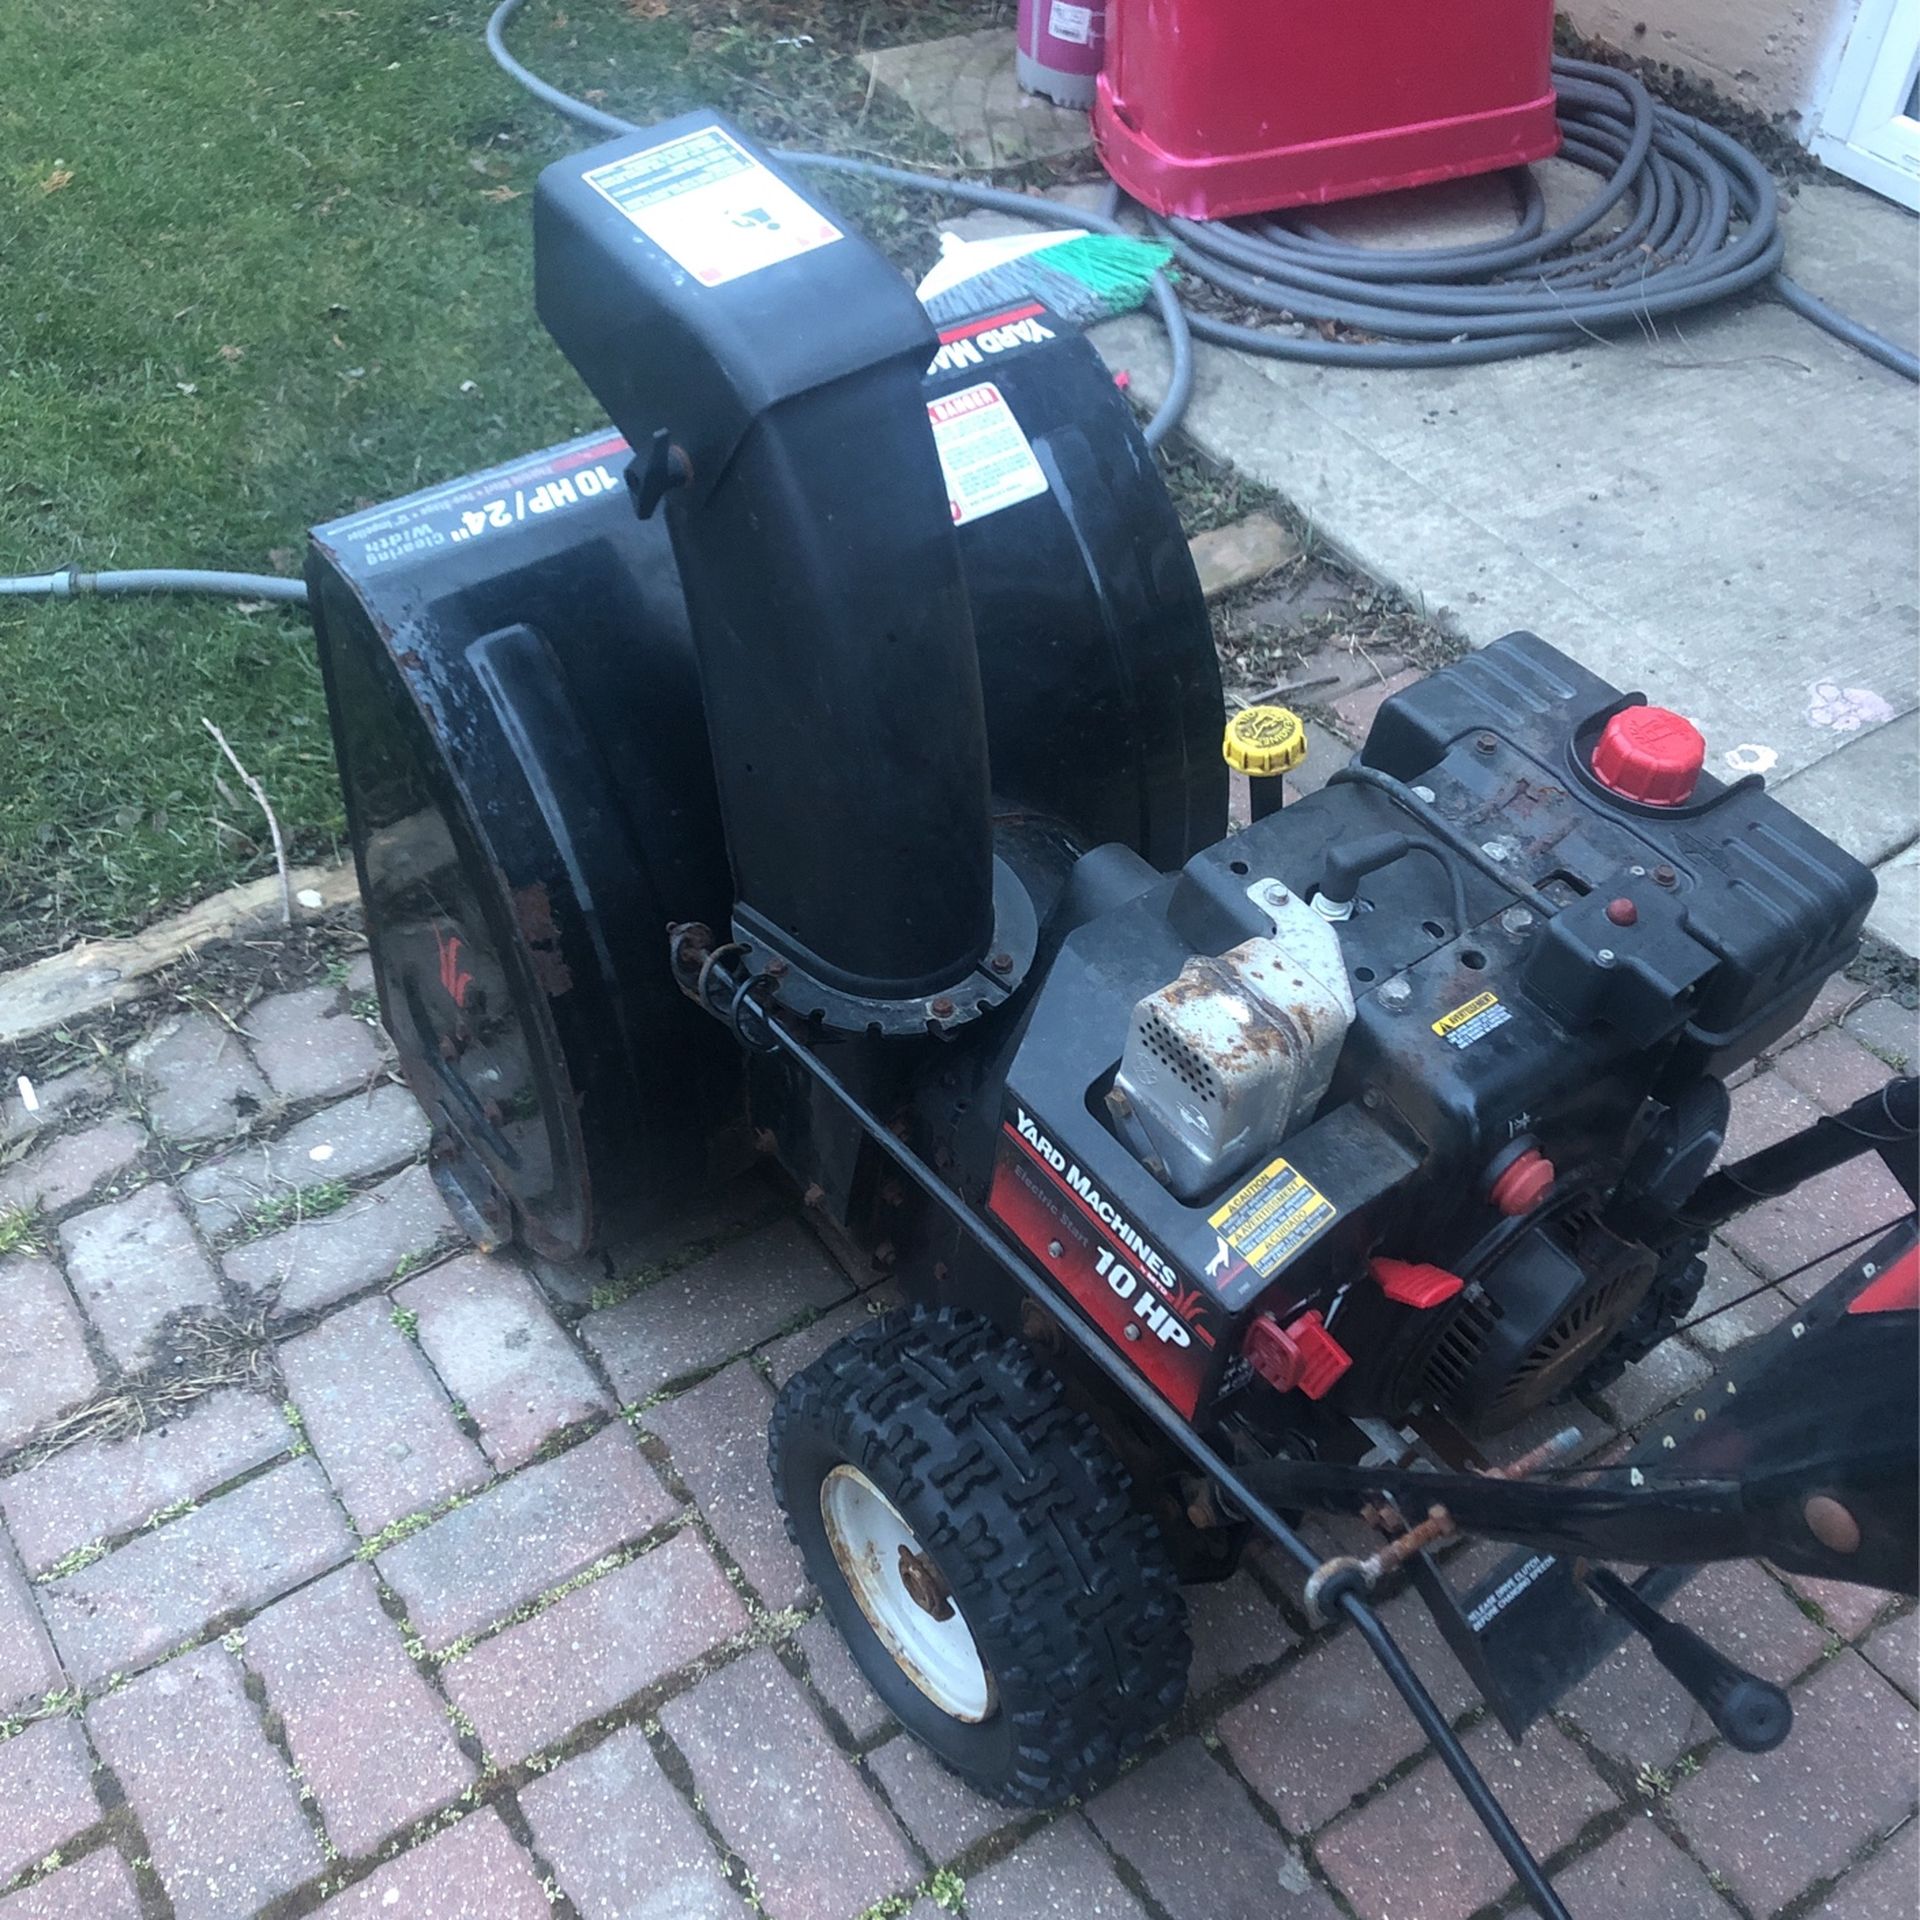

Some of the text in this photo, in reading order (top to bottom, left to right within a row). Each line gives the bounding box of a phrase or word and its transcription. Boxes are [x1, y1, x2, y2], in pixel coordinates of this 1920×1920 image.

[976, 318, 1056, 353] YARD
[574, 466, 618, 497] 10
[365, 523, 432, 553] Width
[365, 533, 444, 566] Clearing
[1013, 1163, 1090, 1248] Electric Start
[1014, 1107, 1178, 1290] YARD MACHINES
[1233, 1173, 1270, 1209] CAUTION
[1269, 1209, 1307, 1244] CUIDADO
[1093, 1245, 1191, 1348] 10 HP
[1494, 1577, 1517, 1599] DRIVE
[1513, 1555, 1541, 1582] CLUTCH
[1472, 1605, 1500, 1632] BEFORE
[1497, 1578, 1532, 1609] CHANGING
